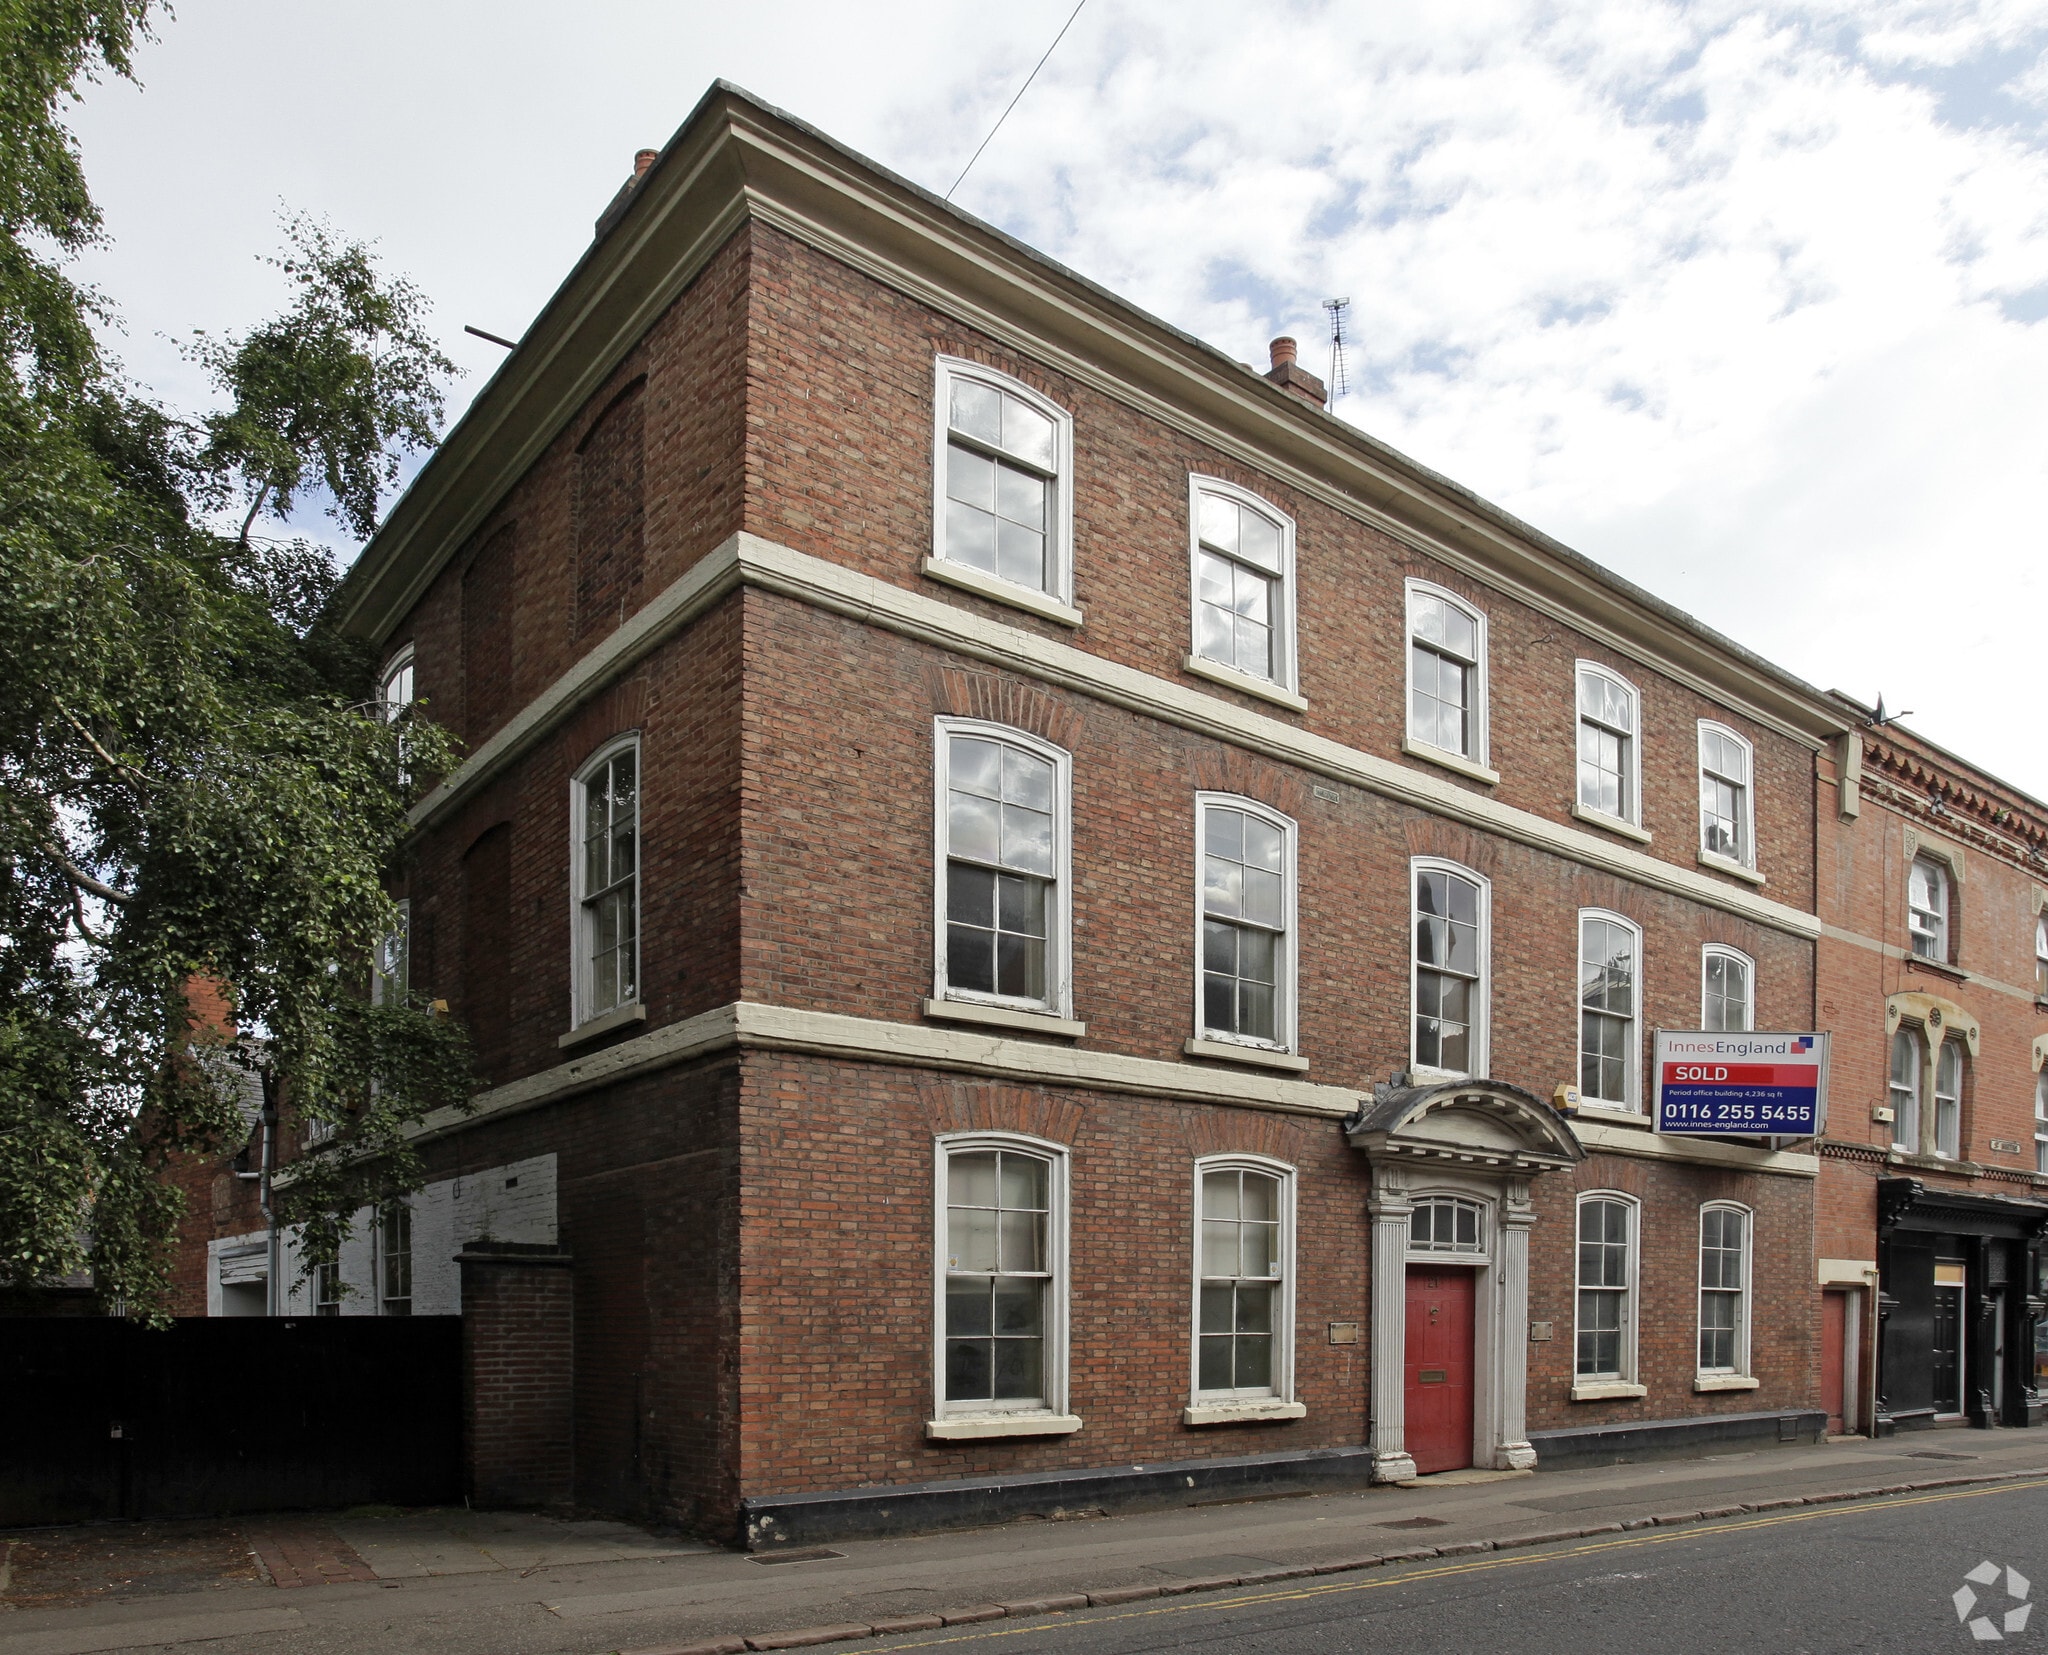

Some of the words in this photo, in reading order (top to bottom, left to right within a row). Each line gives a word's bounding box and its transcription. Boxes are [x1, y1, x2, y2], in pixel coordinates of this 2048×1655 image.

[1669, 1040, 1786, 1056] InnesEngland
[1675, 1066, 1728, 1081] SOLD
[1715, 1090, 1743, 1098] building
[1665, 1103, 1711, 1119] 0116
[1718, 1104, 1755, 1120] 255
[1761, 1105, 1811, 1121] 5455
[1665, 1120, 1769, 1130] www.innes-england.com
